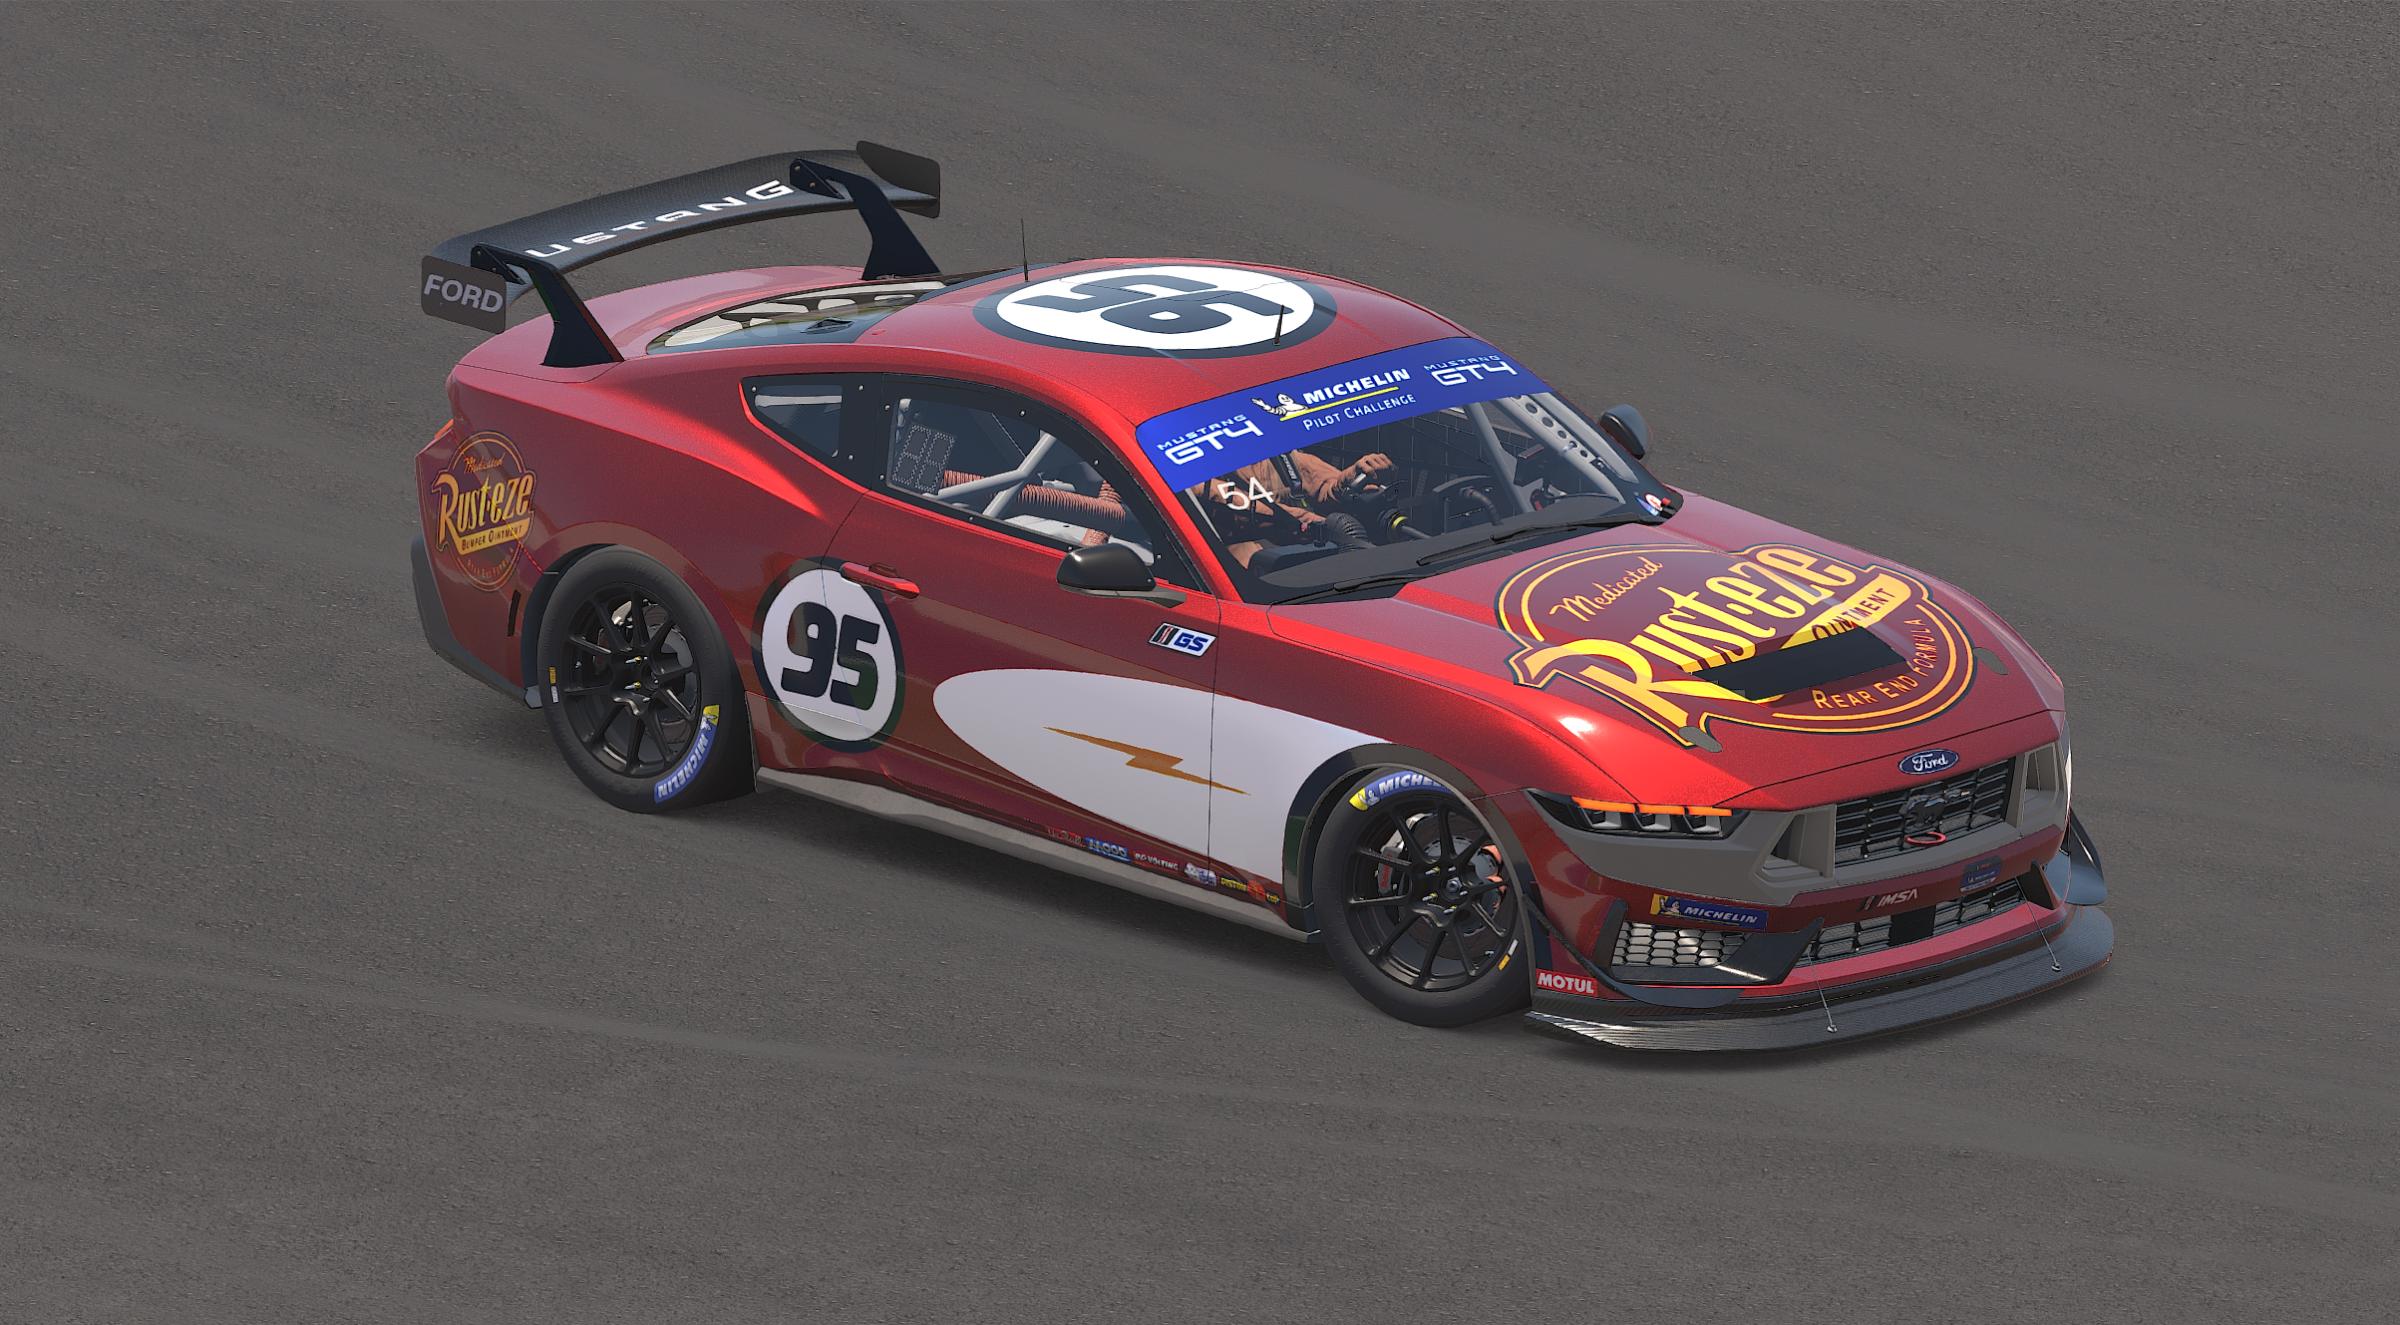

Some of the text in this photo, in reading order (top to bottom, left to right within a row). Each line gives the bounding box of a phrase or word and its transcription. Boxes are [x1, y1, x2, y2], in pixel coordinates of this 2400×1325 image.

[524, 179, 795, 258] USTANG
[423, 273, 504, 314] FORD
[1013, 274, 1295, 334] 95
[1423, 354, 1501, 371] MUSTANG
[1431, 360, 1519, 387] GT4
[1302, 367, 1411, 405] MICHELIN
[1302, 393, 1417, 431] PILOT CHALLENGE
[1156, 414, 1248, 451] MUSTANG
[1164, 419, 1264, 466] GT4
[1217, 476, 1274, 511] 54
[1549, 556, 1664, 622] Medicated
[780, 601, 881, 711] 95
[1173, 632, 1209, 652] GS
[1811, 618, 1938, 709] REAR END FORMULA
[657, 733, 709, 798] MICHELIN
[1911, 753, 1949, 772] Ford
[1684, 906, 1758, 924] MICHELIN
[1876, 888, 1918, 908] IMSA
[1537, 972, 1595, 994] MOTUL
